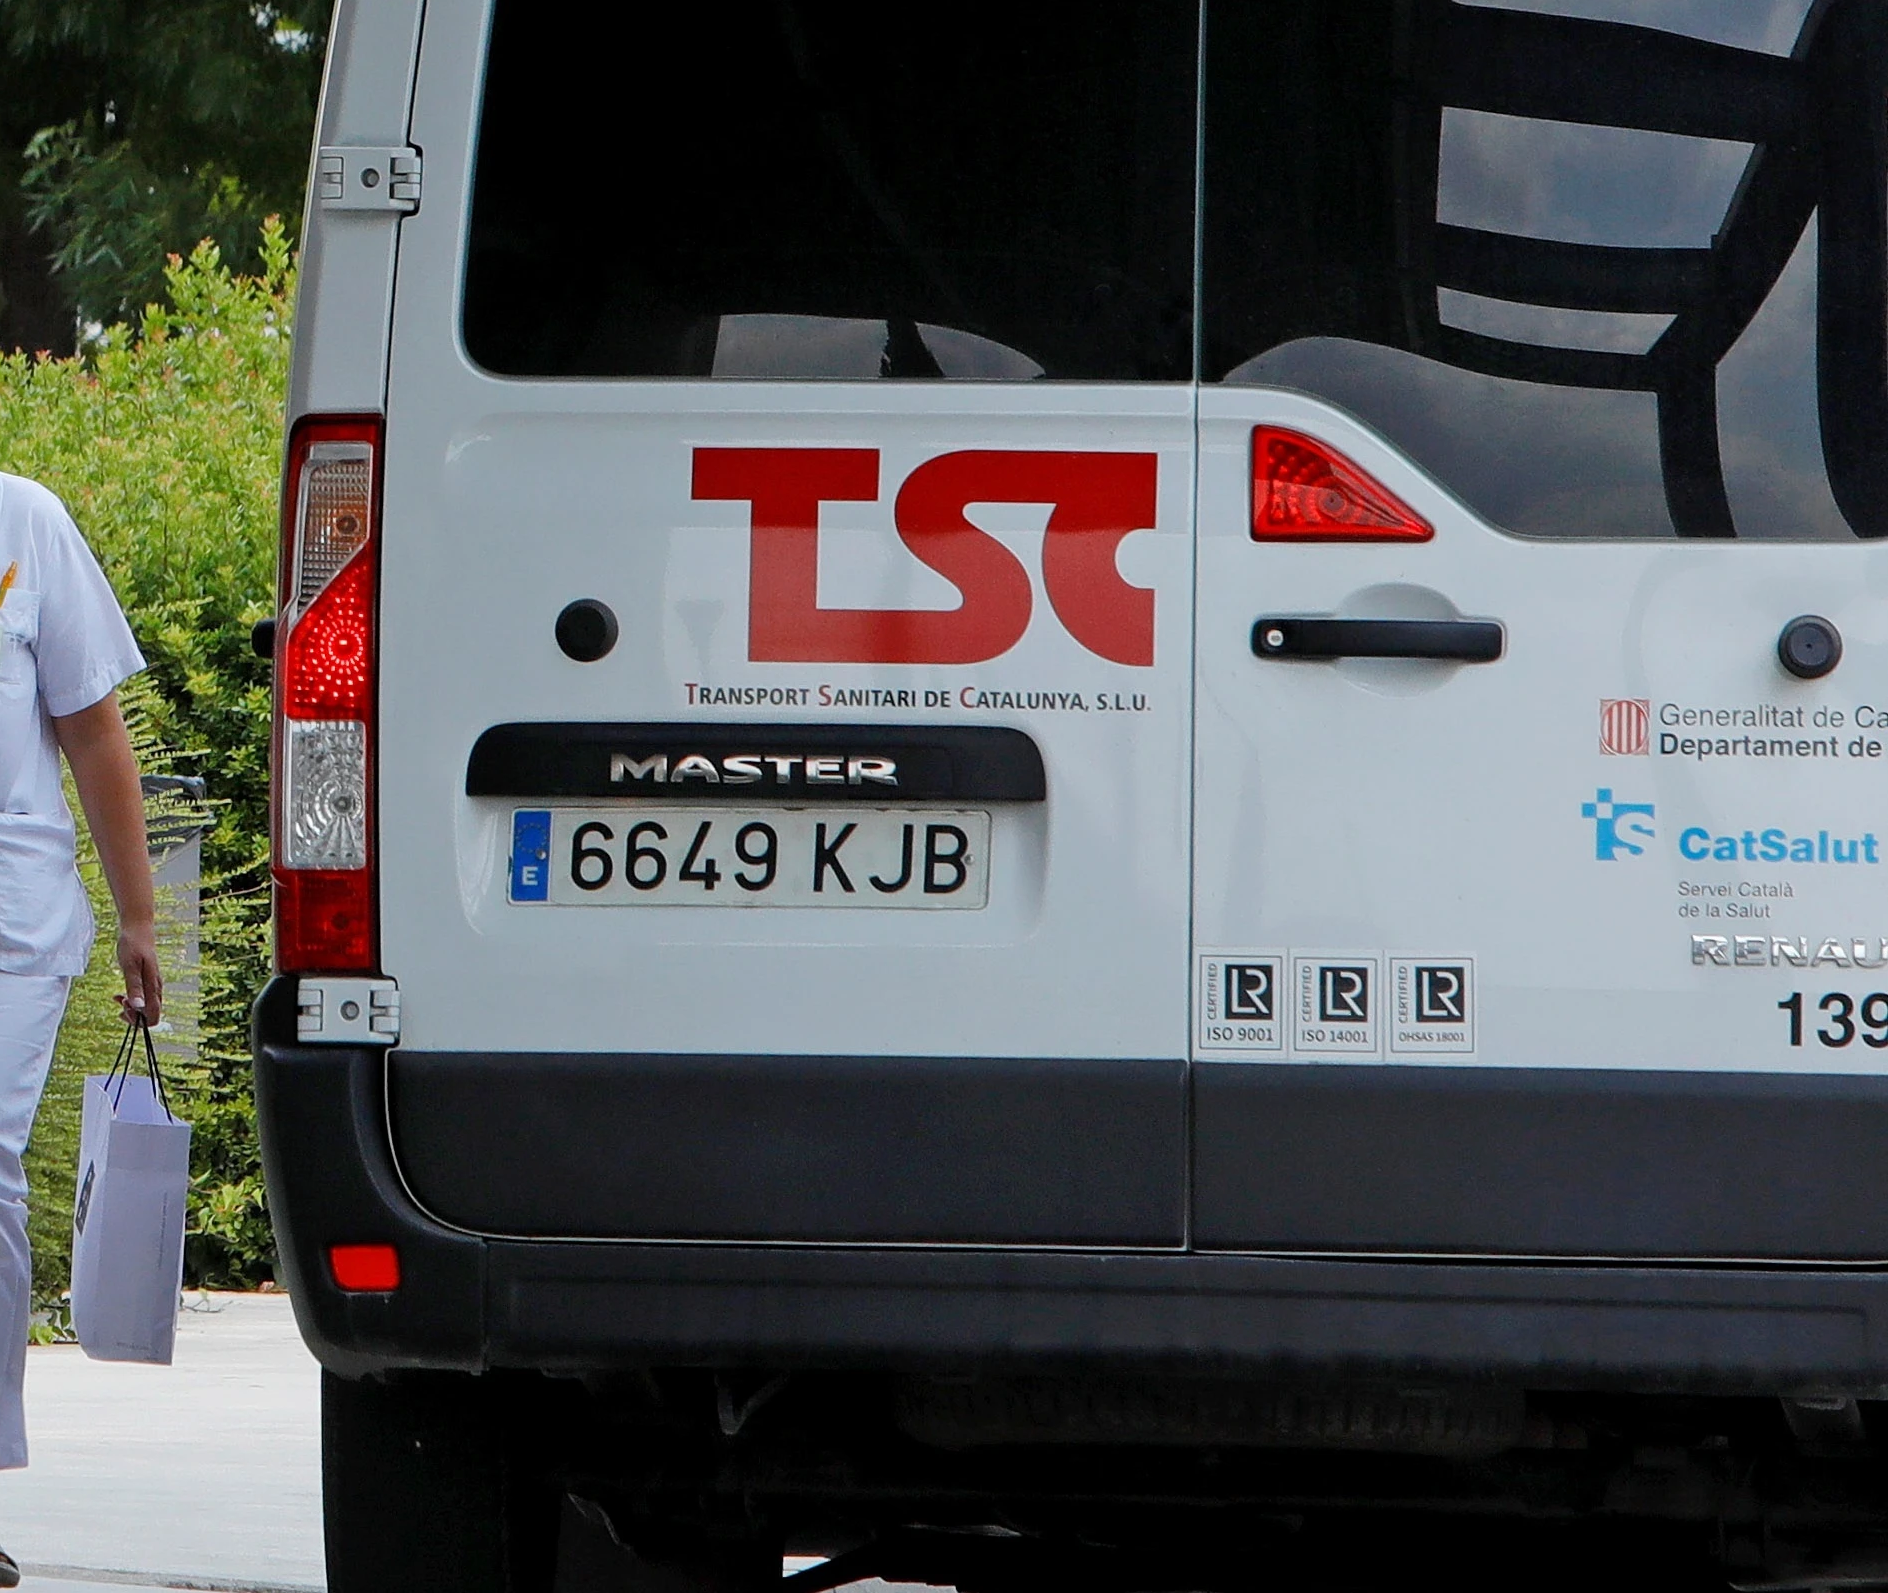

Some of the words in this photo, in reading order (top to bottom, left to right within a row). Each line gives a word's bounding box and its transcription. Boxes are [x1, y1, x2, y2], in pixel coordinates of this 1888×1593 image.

[691, 447, 1158, 666] TSC
[685, 682, 810, 707] TRANSPORT
[818, 684, 917, 708] SANITARI
[924, 689, 951, 708] DE
[959, 686, 1090, 713] CATALUNYA,
[1660, 703, 1803, 728] Generalitat
[1813, 705, 1844, 728] de
[1660, 733, 1838, 760] Departament
[1848, 735, 1883, 758] de
[609, 752, 899, 786] MASTER
[570, 821, 779, 893] 6649
[812, 822, 969, 894] KJB
[1679, 827, 1879, 864] CatSalut
[521, 865, 538, 888] E
[1678, 881, 1732, 897] Servei
[1738, 881, 1794, 898] Català
[1678, 903, 1700, 918] de
[1705, 903, 1720, 918] la
[1726, 903, 1771, 919] Salut
[1690, 934, 1888, 969] RENAU
[1207, 962, 1218, 1020] CERTIFIED
[1302, 965, 1312, 1023] CERTIFIED
[1398, 965, 1408, 1023] CERTIFIED
[1207, 1027, 1233, 1041] ISO
[1239, 1028, 1273, 1041] 9001
[1301, 1029, 1324, 1042] ISO
[1329, 1030, 1368, 1043] 14001
[1399, 1031, 1434, 1042] OHSAS
[1436, 1032, 1465, 1042] 18001
